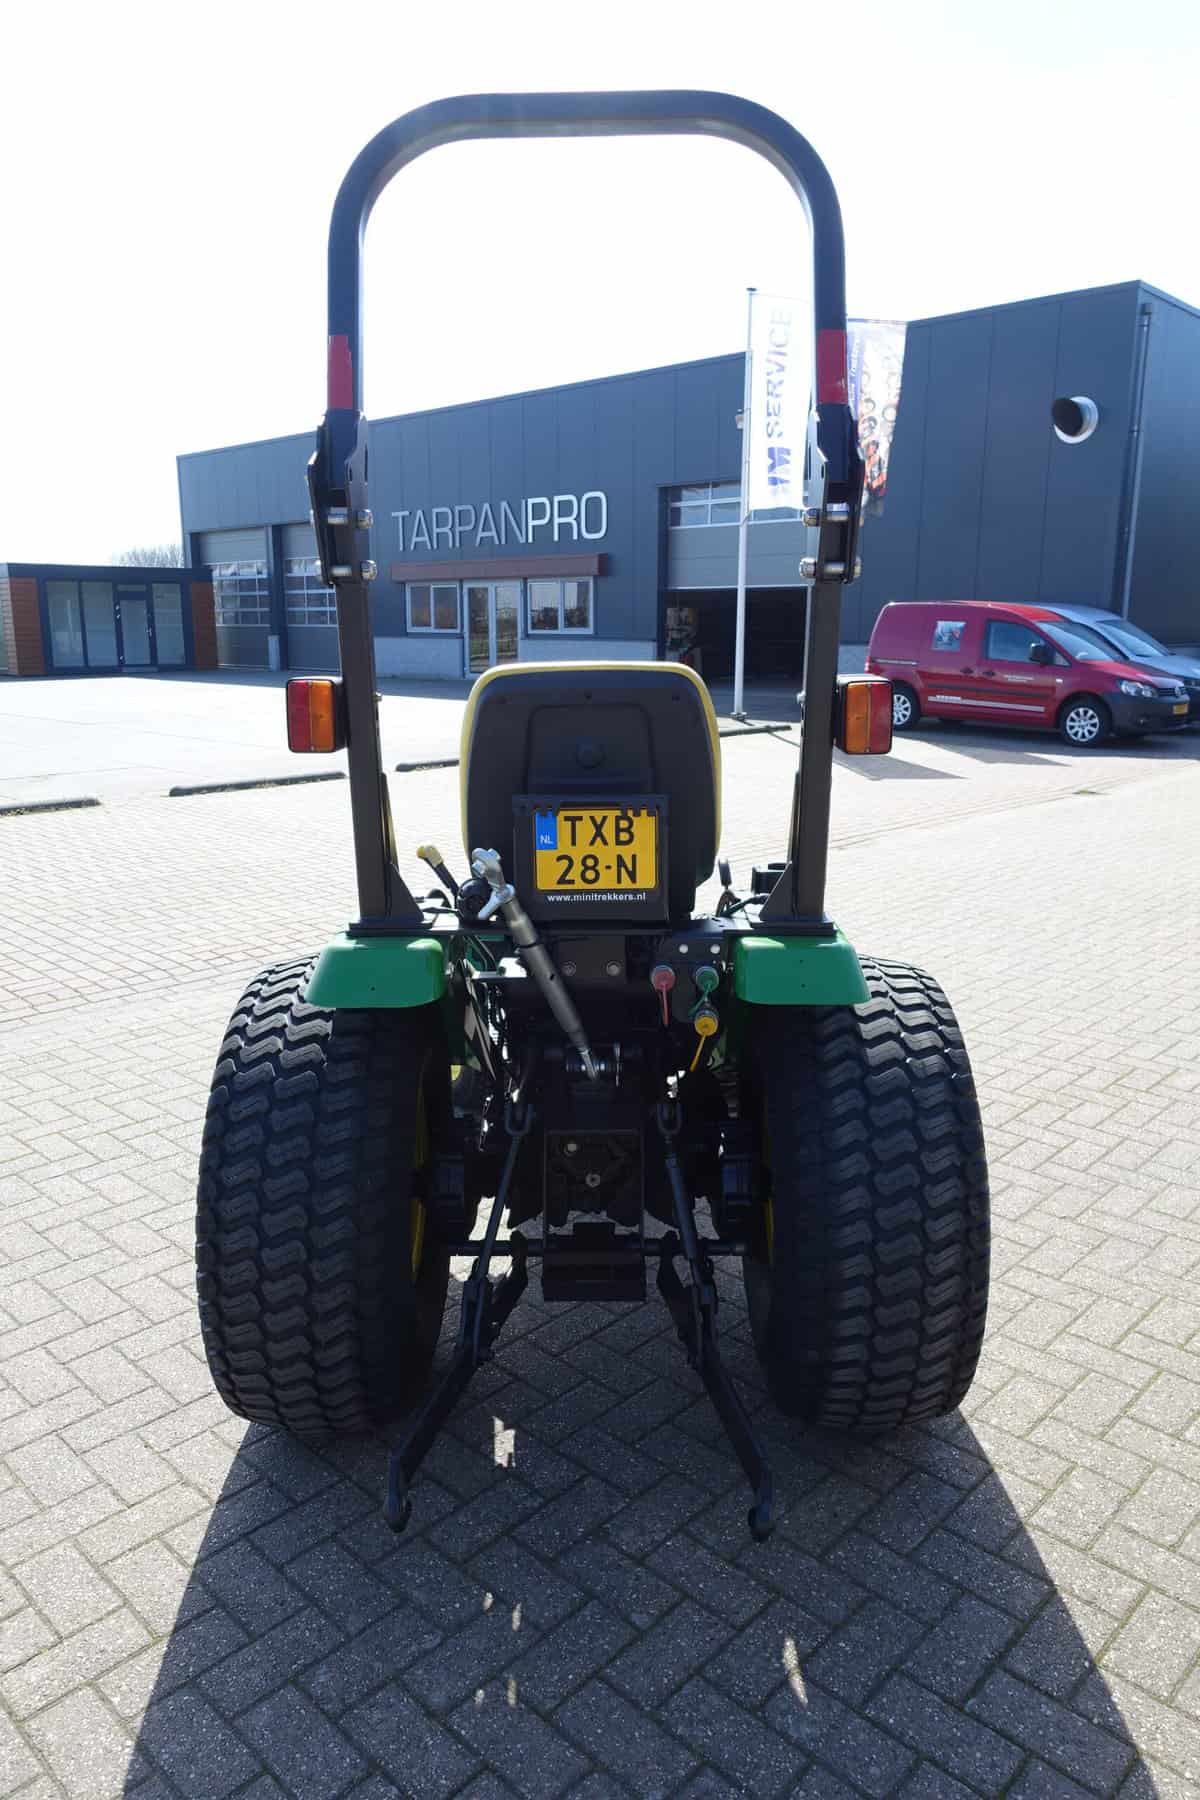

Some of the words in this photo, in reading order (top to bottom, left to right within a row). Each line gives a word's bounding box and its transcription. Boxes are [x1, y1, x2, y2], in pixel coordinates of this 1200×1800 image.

[766, 308, 791, 438] SERVICE
[391, 490, 608, 552] TARPANPRO
[540, 834, 553, 845] NL
[563, 815, 635, 846] TXB
[556, 854, 637, 885] 28-N
[547, 892, 646, 902] www.minitrekkers.nl
